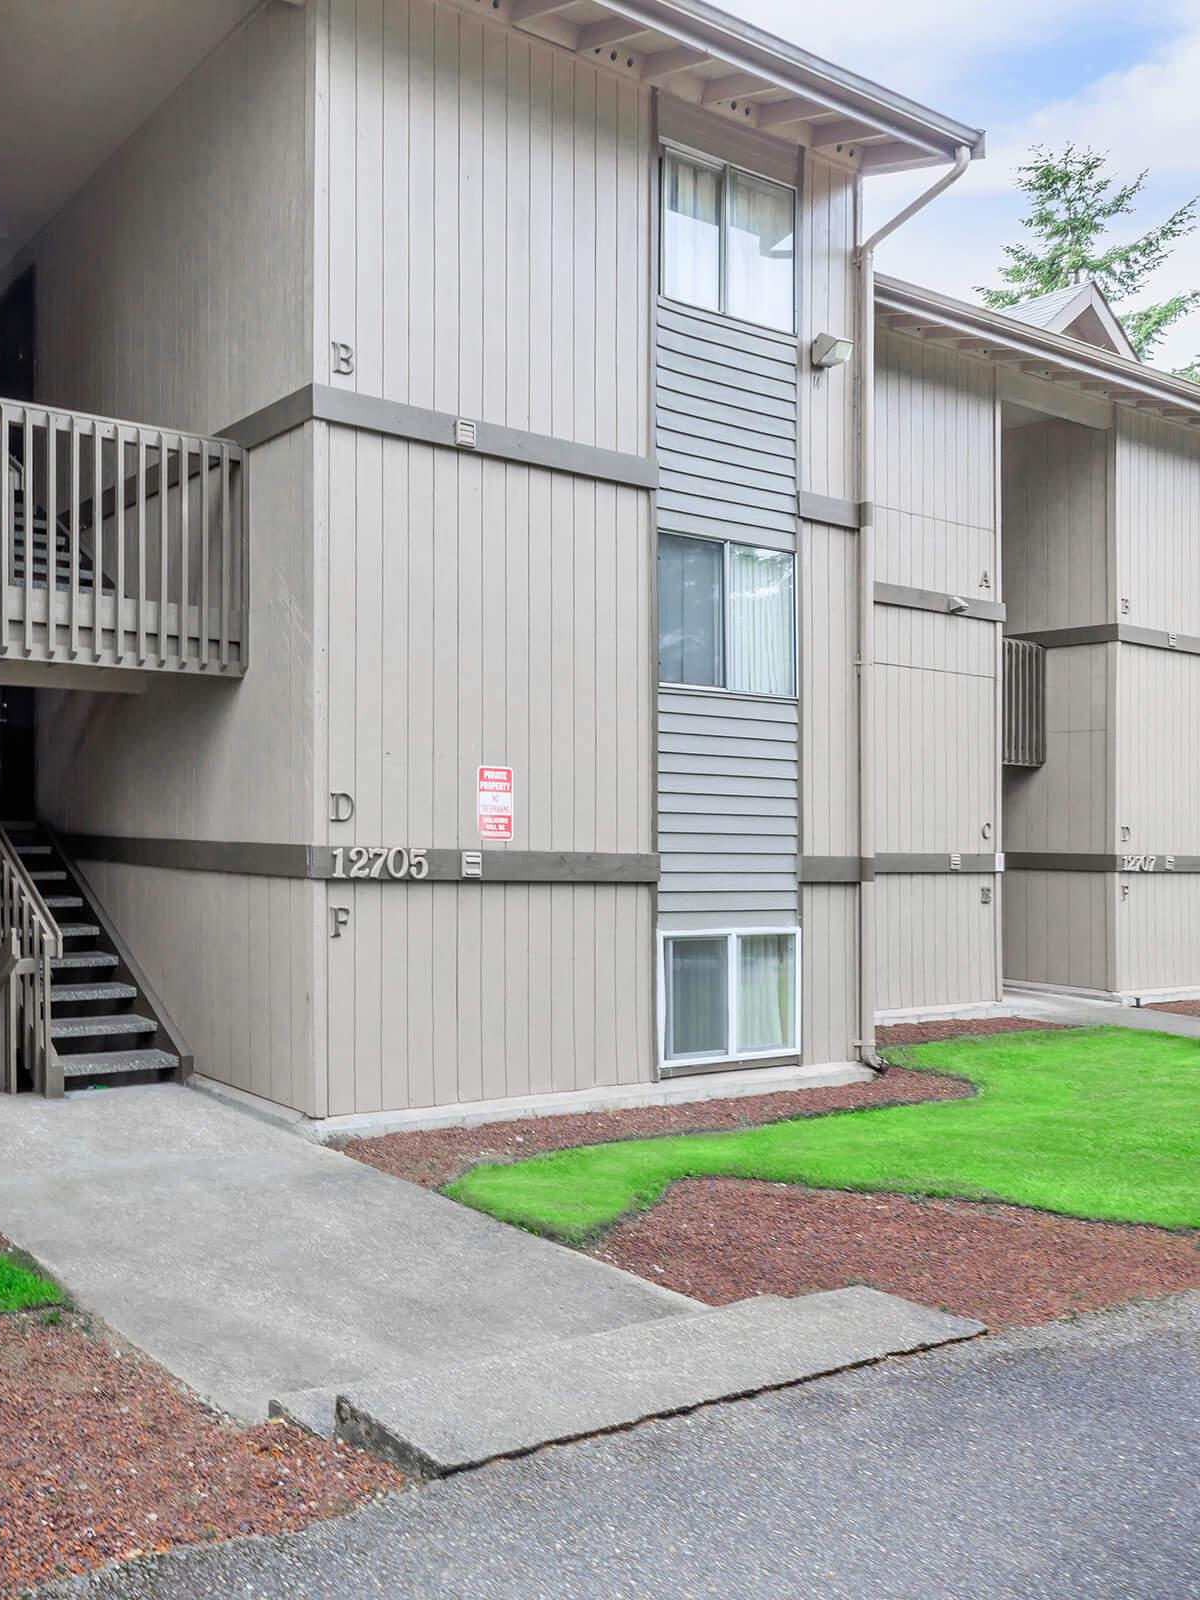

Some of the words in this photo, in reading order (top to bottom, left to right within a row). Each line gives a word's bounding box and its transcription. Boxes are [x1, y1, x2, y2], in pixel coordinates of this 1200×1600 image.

[332, 341, 354, 375] B
[978, 570, 991, 588] A
[480, 781, 511, 791] PROPERTY
[330, 791, 354, 822] D
[982, 822, 991, 840] C
[1121, 826, 1131, 842] D
[332, 847, 429, 879] 12705
[1122, 855, 1156, 871] 12707
[1121, 885, 1129, 901] F
[330, 906, 350, 938] F
